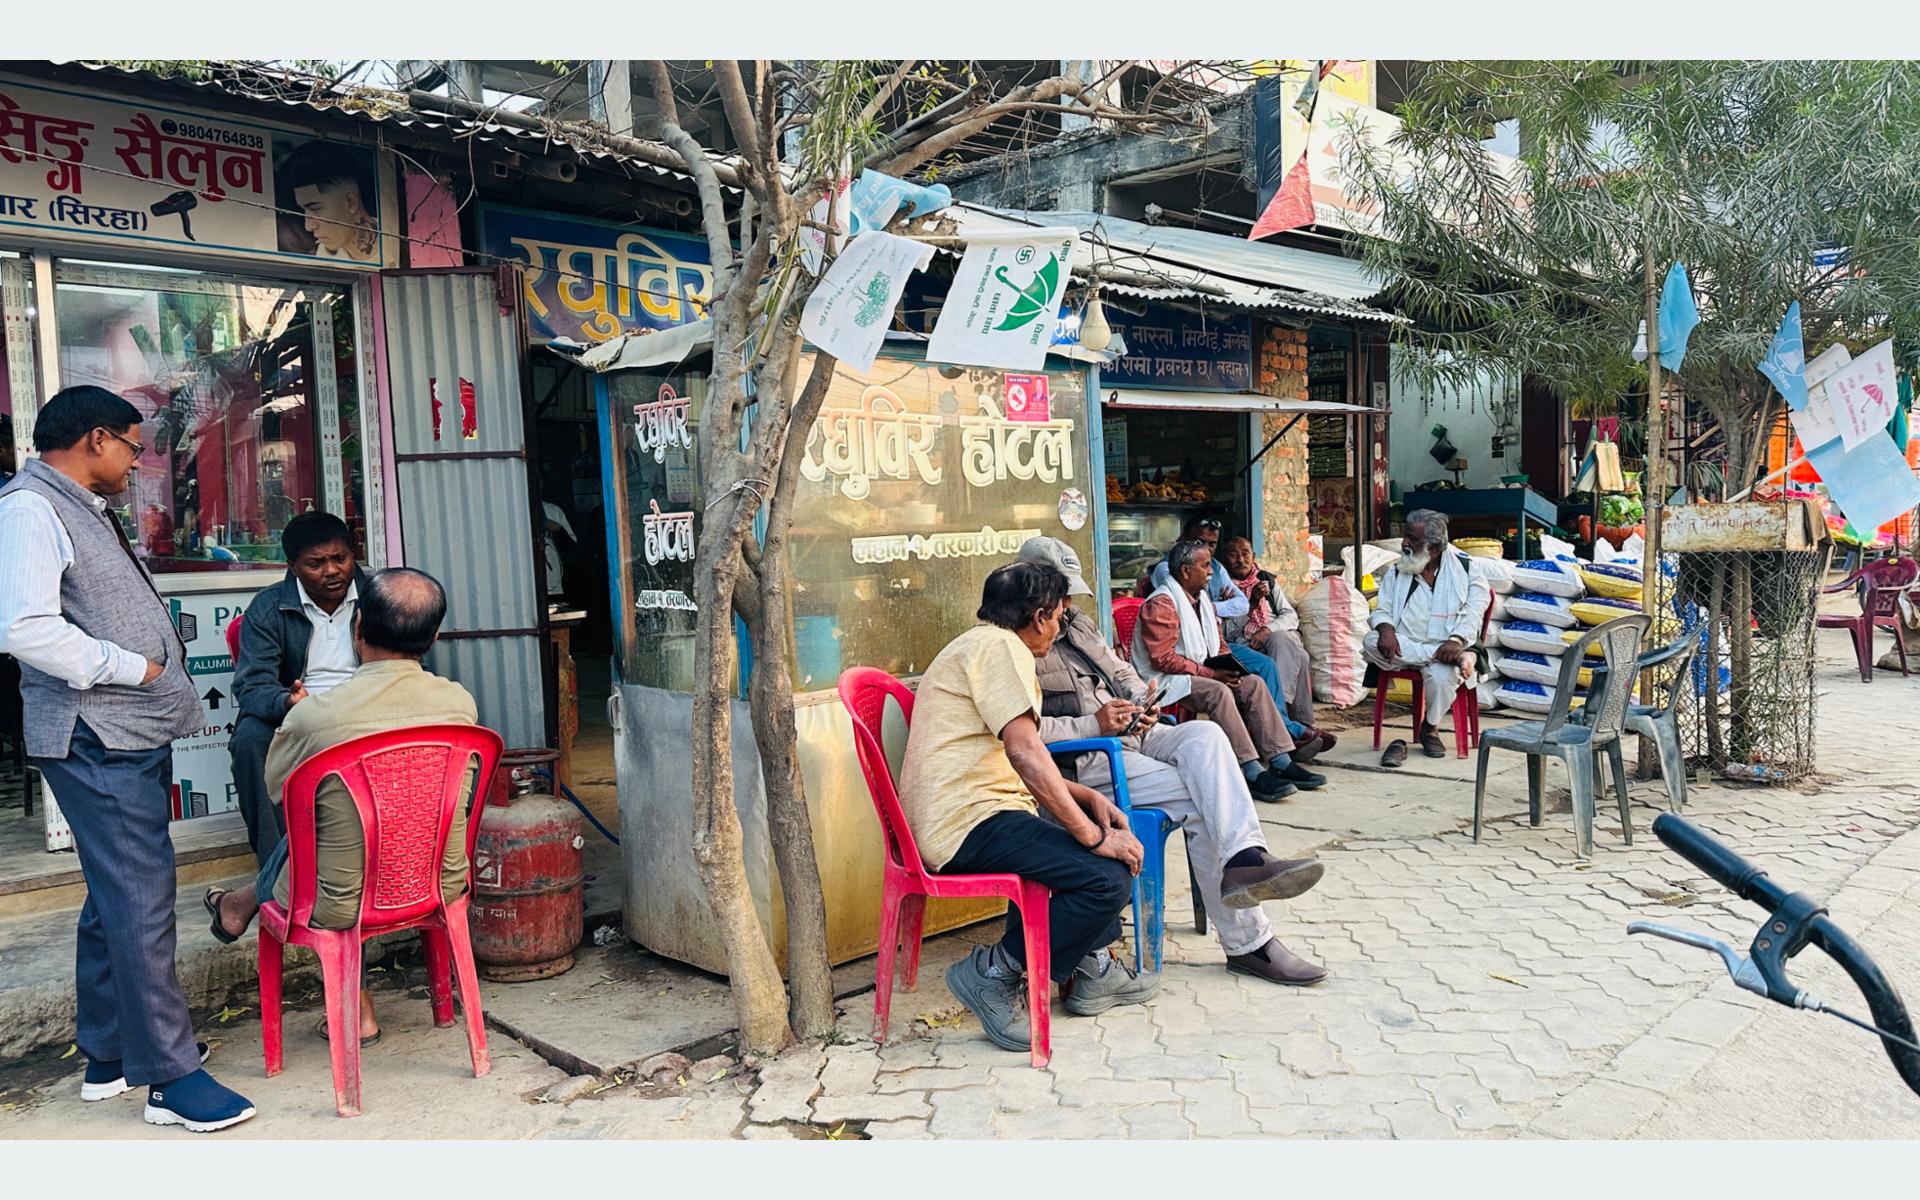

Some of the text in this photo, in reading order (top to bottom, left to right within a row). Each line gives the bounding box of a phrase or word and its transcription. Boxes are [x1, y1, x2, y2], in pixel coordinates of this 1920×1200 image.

[179, 122, 264, 149] 9804764838
[114, 112, 266, 201] सैलुन
[0, 195, 148, 231] ार (सिरहा)
[800, 385, 1074, 501] रघुविर होटल
[643, 498, 695, 566] होटल
[852, 535, 909, 563] लहान
[930, 525, 997, 558] तरकारी
[203, 725, 222, 737] UP
